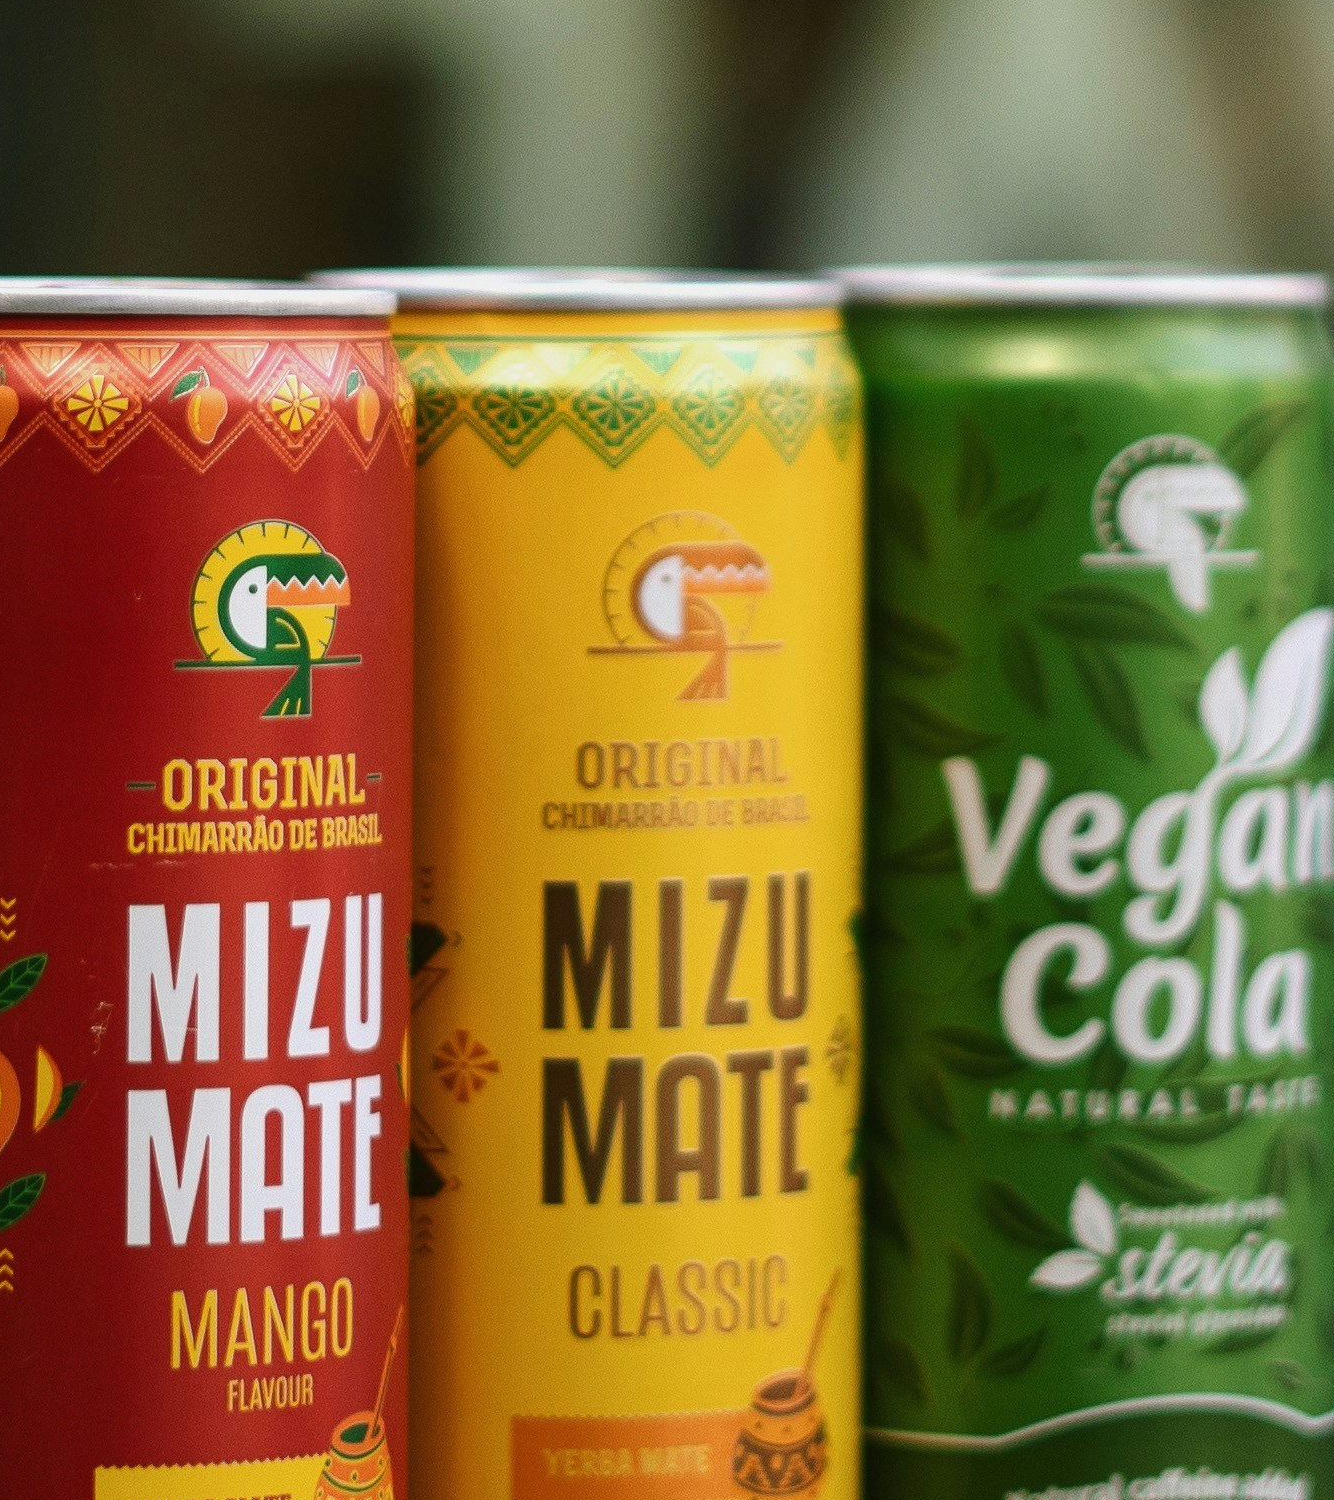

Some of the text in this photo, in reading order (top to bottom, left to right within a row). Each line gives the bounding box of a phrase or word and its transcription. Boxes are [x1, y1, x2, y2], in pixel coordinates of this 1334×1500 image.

[163, 753, 366, 811] ORIGINAL
[576, 737, 789, 790] ORIGINAL
[127, 813, 382, 854] CHIMARRÃO DE BRASIL
[542, 793, 699, 830] CHIMARRÃO
[705, 797, 735, 828] DE
[127, 893, 382, 1063] MIZU
[541, 870, 811, 1031] MIZU
[999, 900, 1311, 1063] Cola
[541, 1045, 810, 1205] MATE
[988, 1087, 1200, 1120] NATURAL
[126, 1074, 381, 1246] MATE
[569, 1253, 789, 1340] CLASSIC
[1100, 1231, 1291, 1300] stevia
[170, 1277, 353, 1369] MANGO
[228, 1374, 314, 1411] FLAVOUR
[542, 1443, 712, 1478] YERBA MATE
